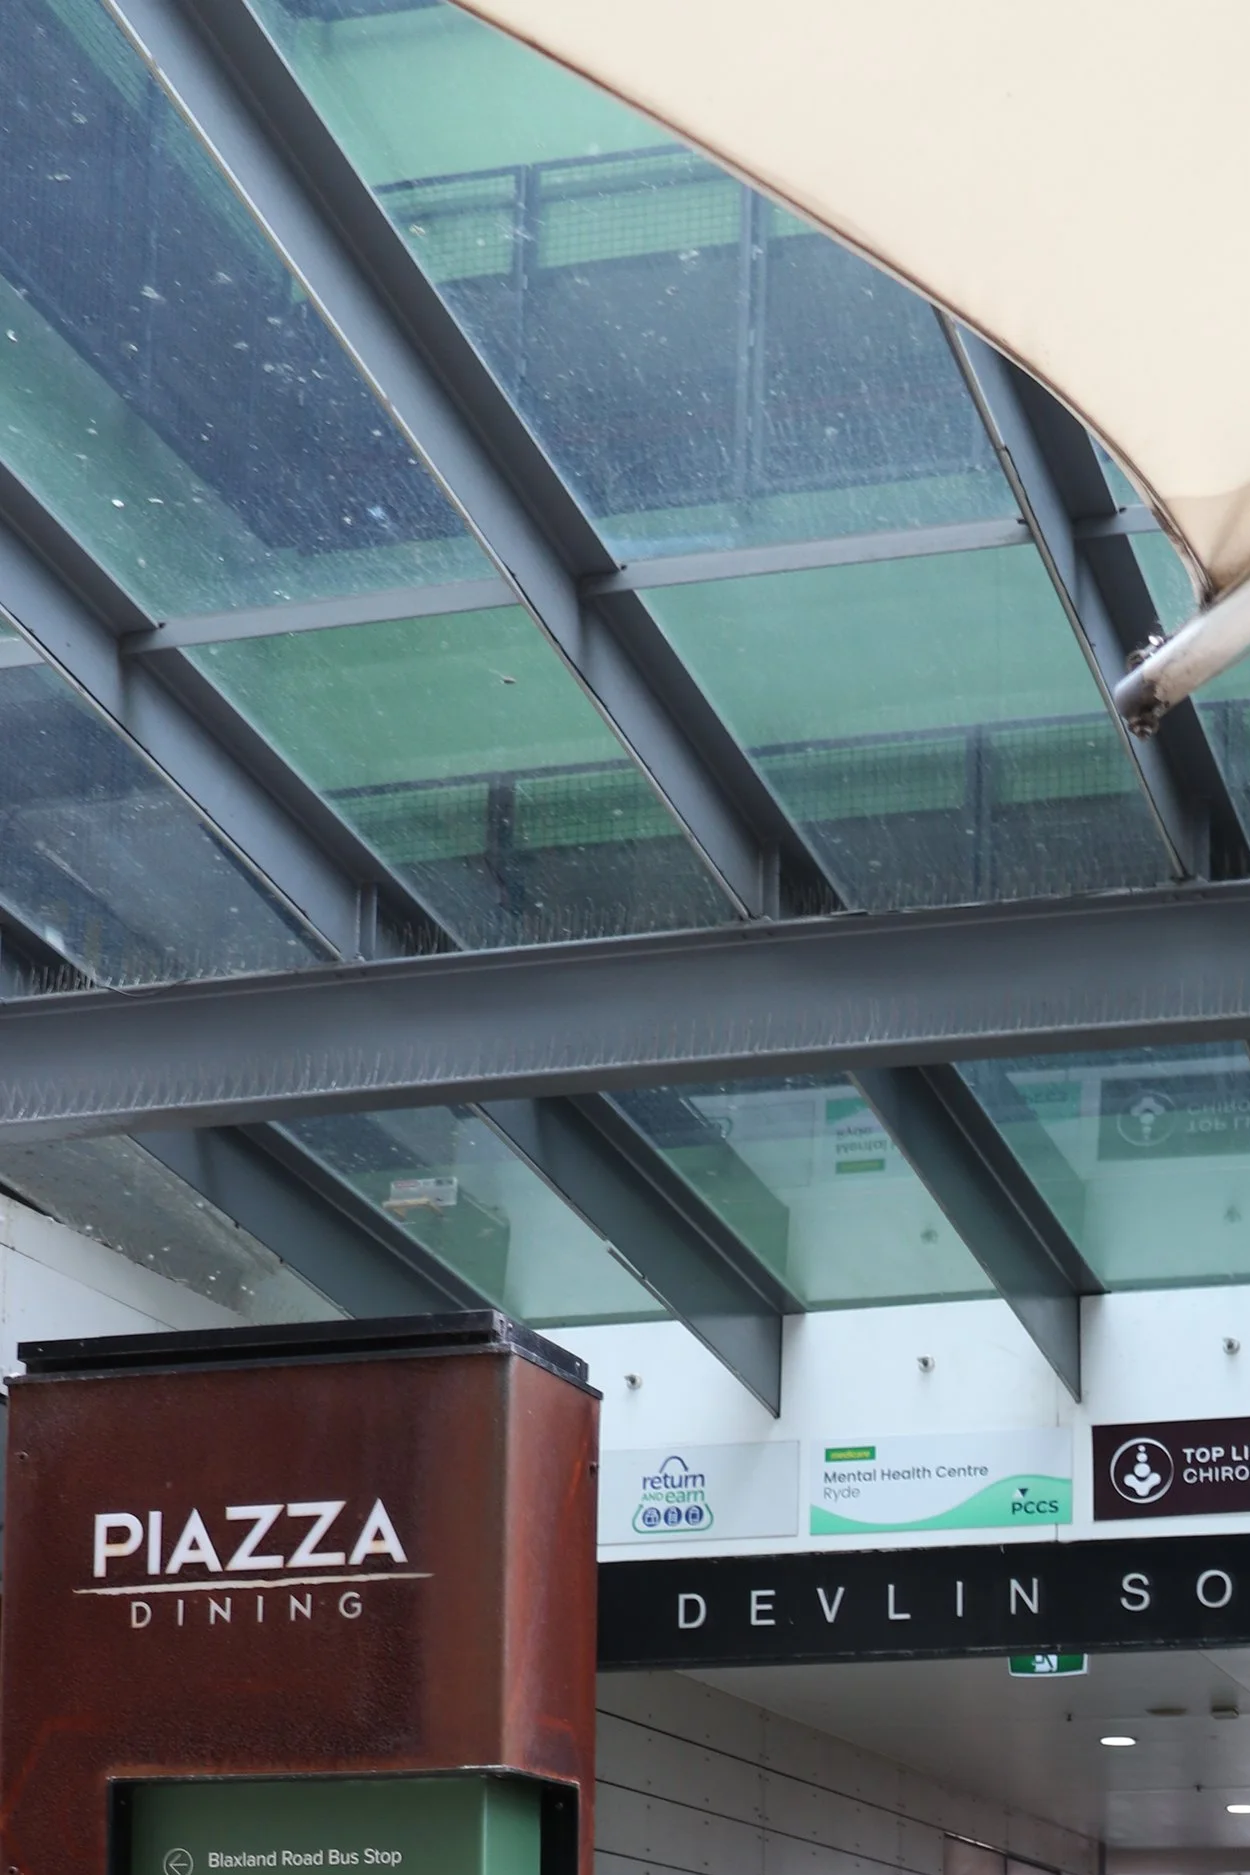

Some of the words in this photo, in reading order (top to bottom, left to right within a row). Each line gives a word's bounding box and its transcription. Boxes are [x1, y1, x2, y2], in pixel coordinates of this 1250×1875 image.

[1182, 1447, 1225, 1464] TOP
[642, 1473, 705, 1490] return
[823, 1469, 877, 1484] Mental
[881, 1466, 932, 1481] Health
[936, 1464, 989, 1479] Centre
[642, 1491, 664, 1502] AND
[665, 1490, 705, 1503] earn
[823, 1486, 861, 1503] Ryde
[1011, 1500, 1060, 1515] PCCS
[93, 1497, 408, 1578] PIAZZA
[131, 1592, 363, 1629] DINING
[677, 1577, 1040, 1629] DEVLIN
[208, 1850, 277, 1868] Blaxland
[281, 1849, 324, 1866] Road
[328, 1848, 360, 1865] Bus
[363, 1847, 403, 1867] Stop
